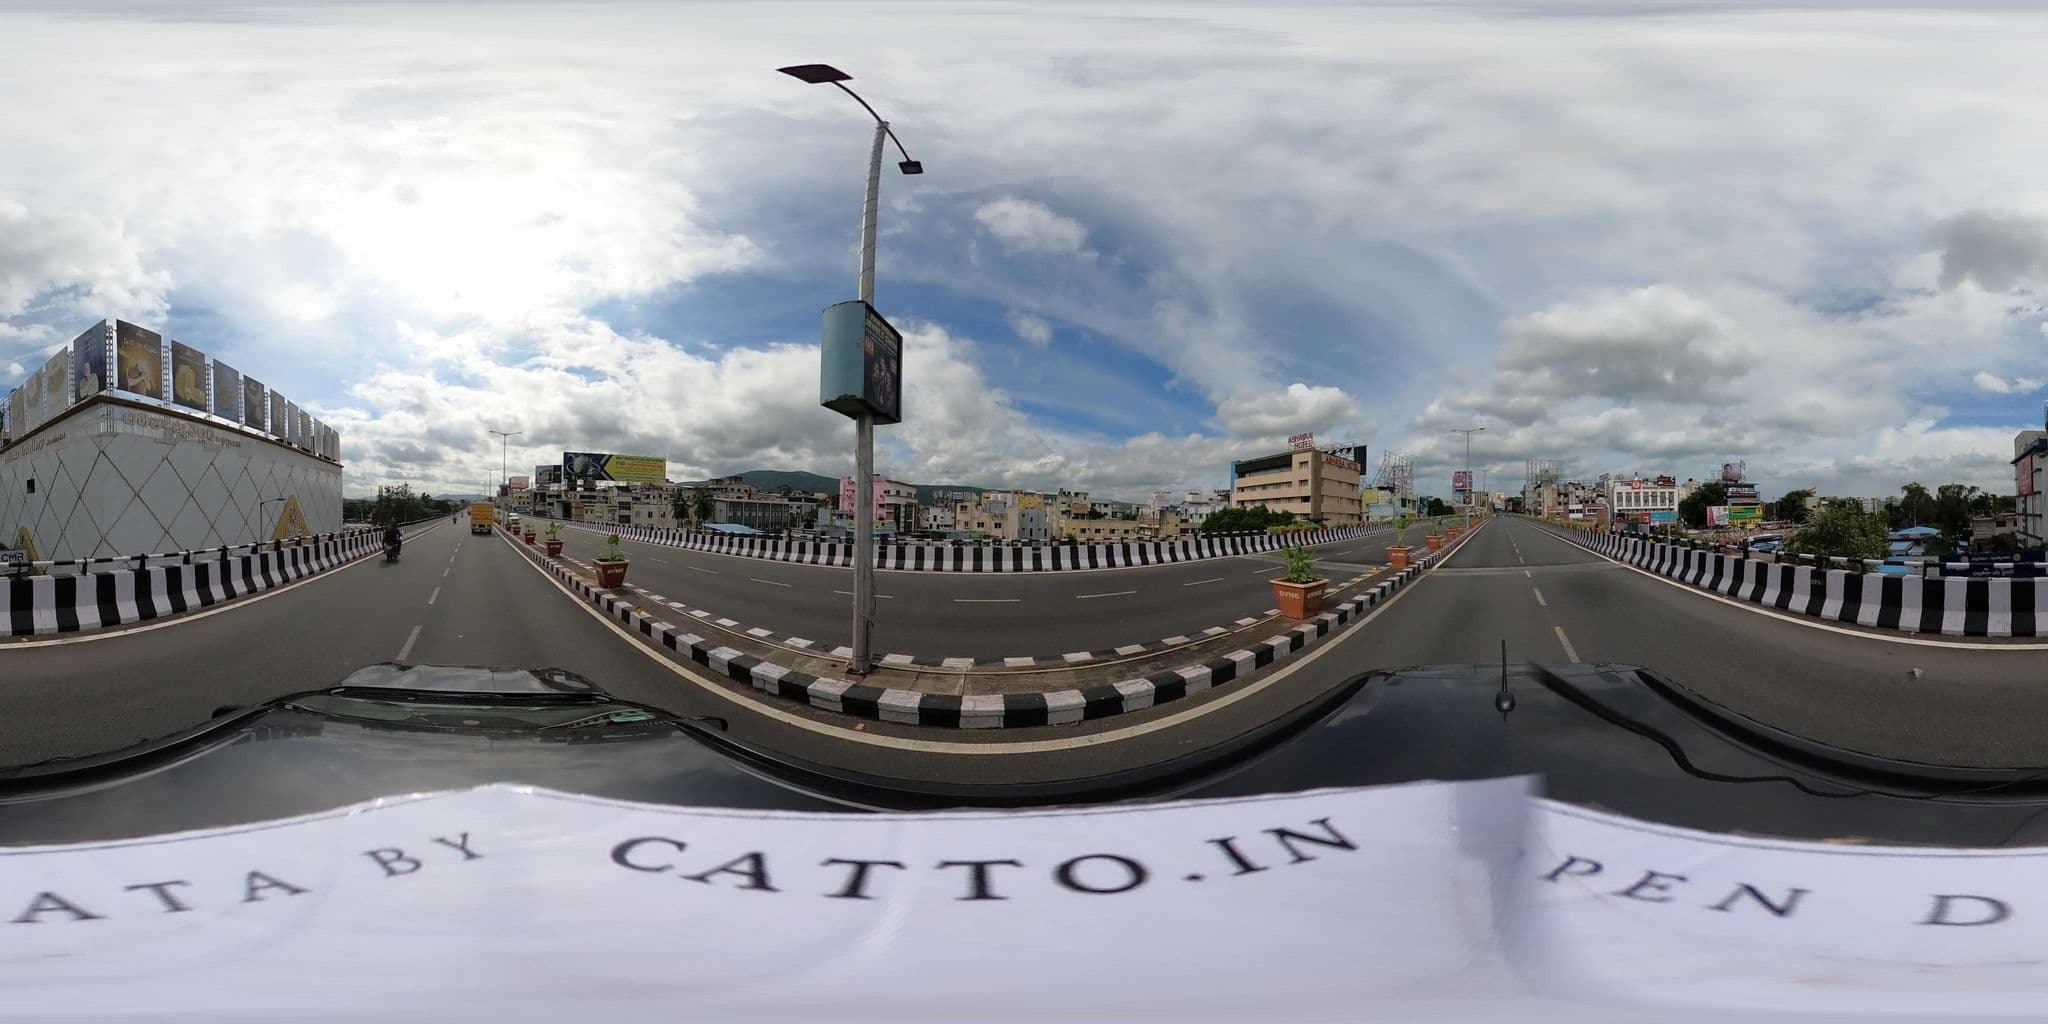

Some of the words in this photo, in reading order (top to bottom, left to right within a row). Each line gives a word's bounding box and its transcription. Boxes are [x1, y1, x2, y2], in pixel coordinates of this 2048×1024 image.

[1, 552, 24, 562] CMR
[363, 832, 485, 877] BY
[611, 817, 1361, 902] CATTO.IN
